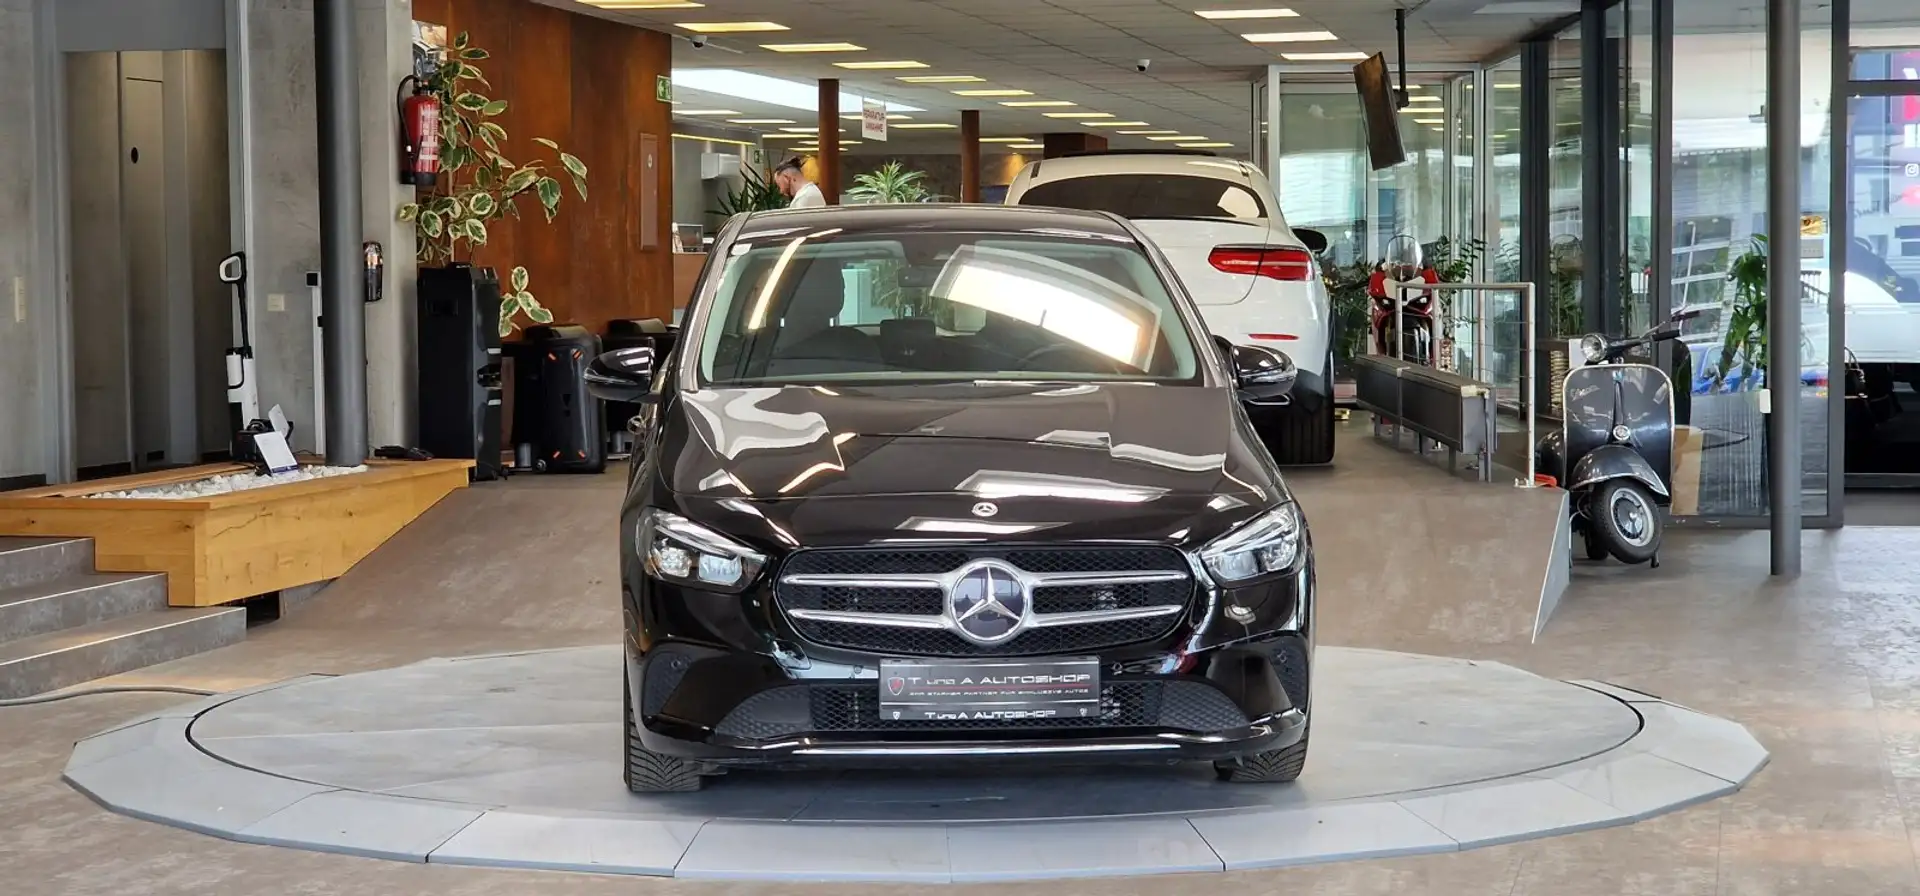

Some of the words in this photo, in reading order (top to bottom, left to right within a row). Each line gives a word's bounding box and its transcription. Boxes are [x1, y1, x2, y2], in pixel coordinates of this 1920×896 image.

[907, 677, 921, 685] T
[961, 677, 974, 685] A
[980, 674, 1091, 685] AUTOSHOP
[974, 710, 1057, 719] AUTOSHOP
